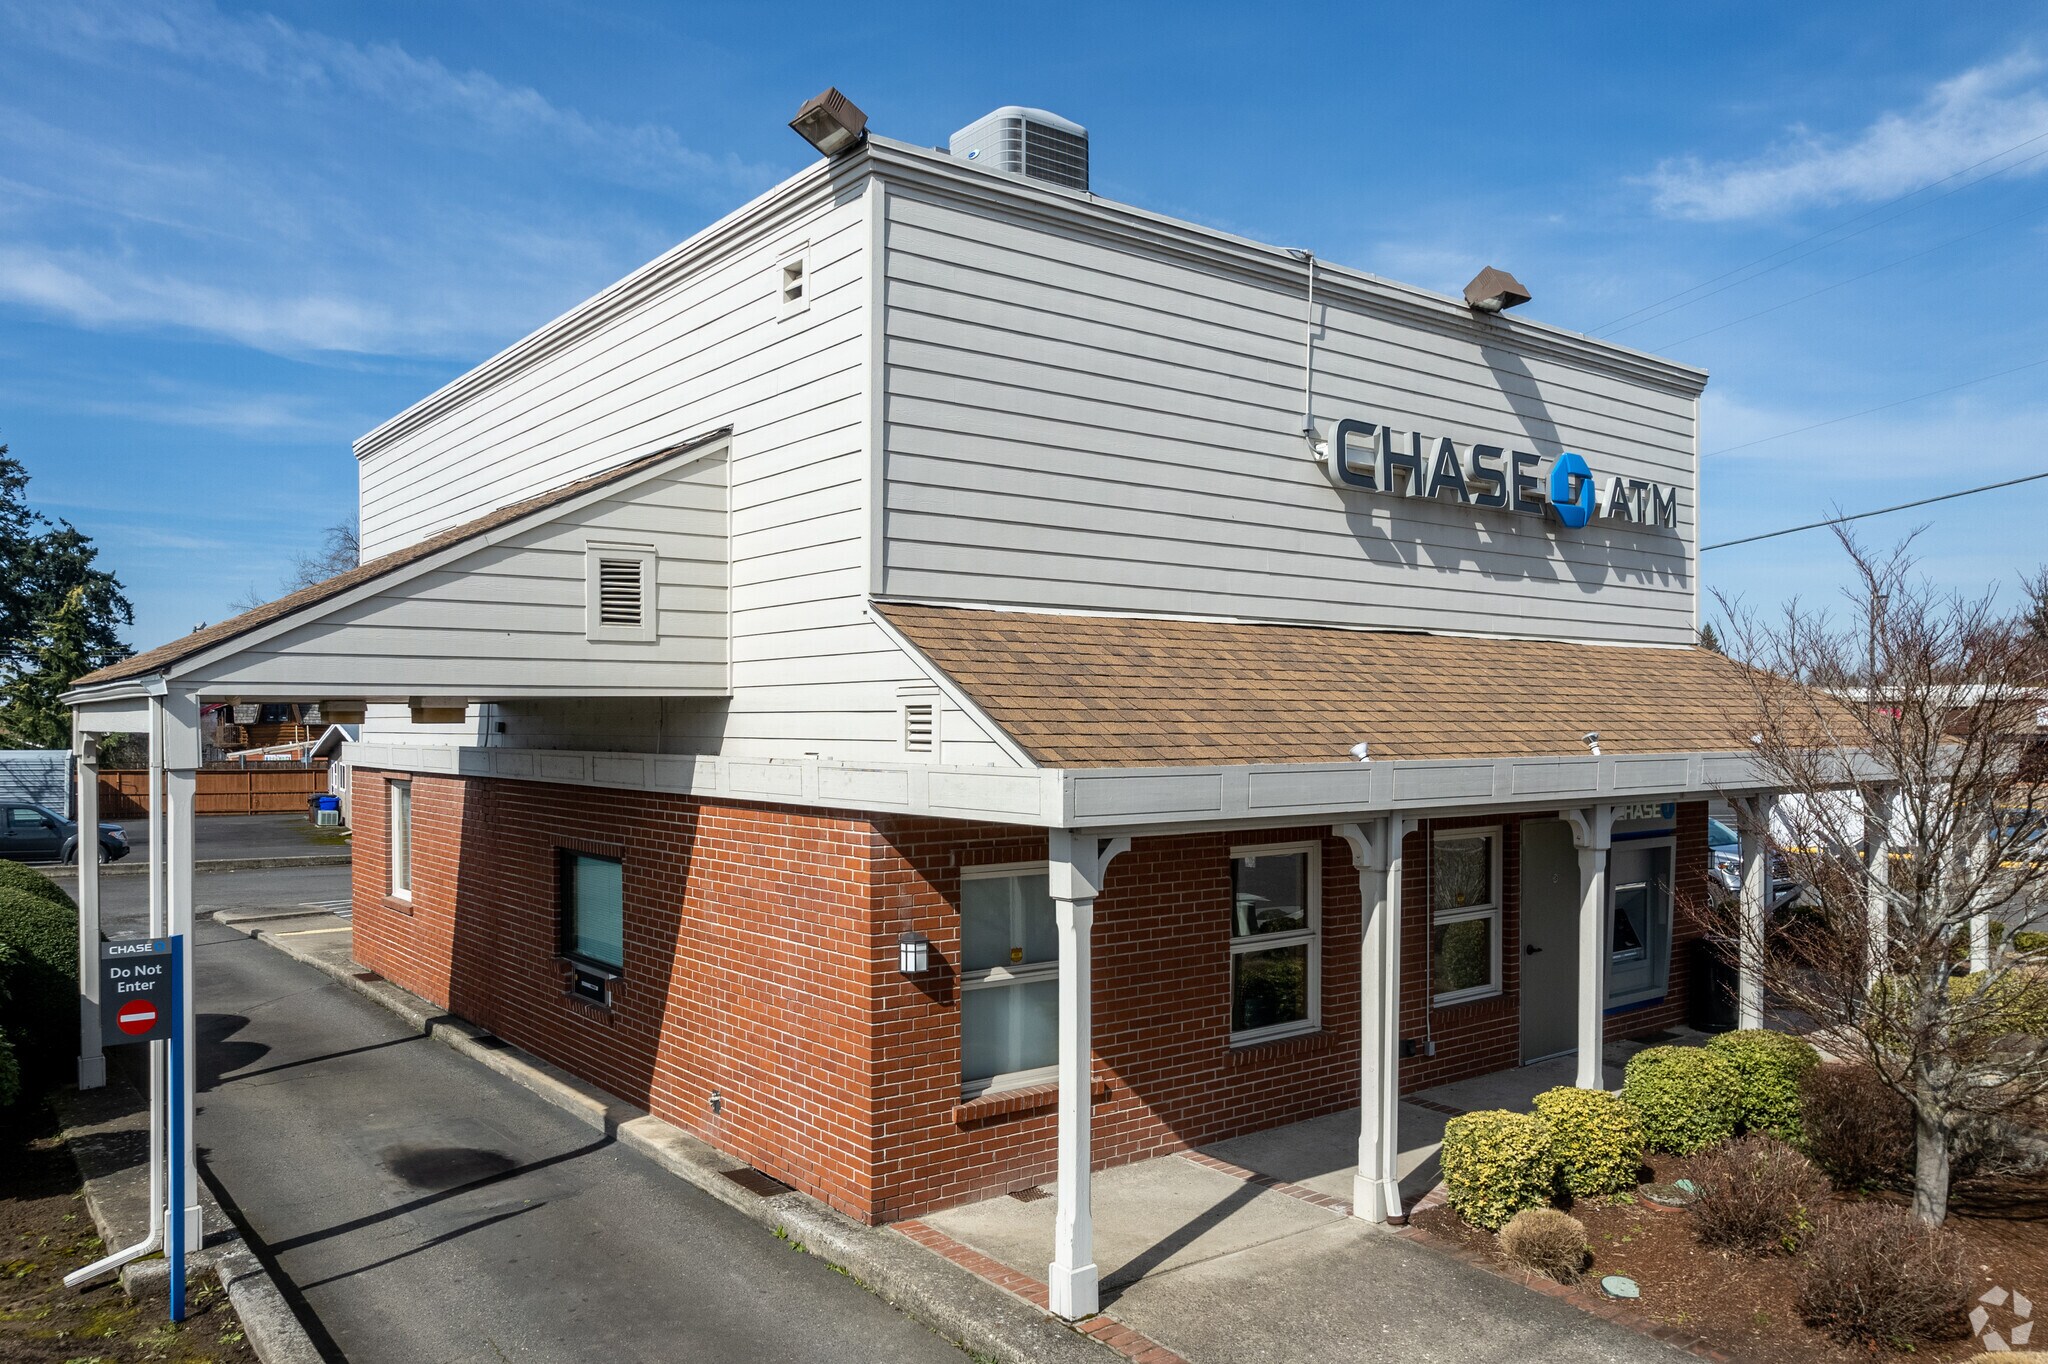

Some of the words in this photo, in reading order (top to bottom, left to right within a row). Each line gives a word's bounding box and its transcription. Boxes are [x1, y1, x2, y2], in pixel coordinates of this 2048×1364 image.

[1328, 418, 1545, 516] CHASE
[1600, 476, 1678, 529] ATM
[1616, 802, 1662, 820] HASE
[109, 943, 152, 955] CHASE
[110, 967, 131, 979] Do
[134, 964, 162, 977] Not
[117, 981, 156, 993] Enter
